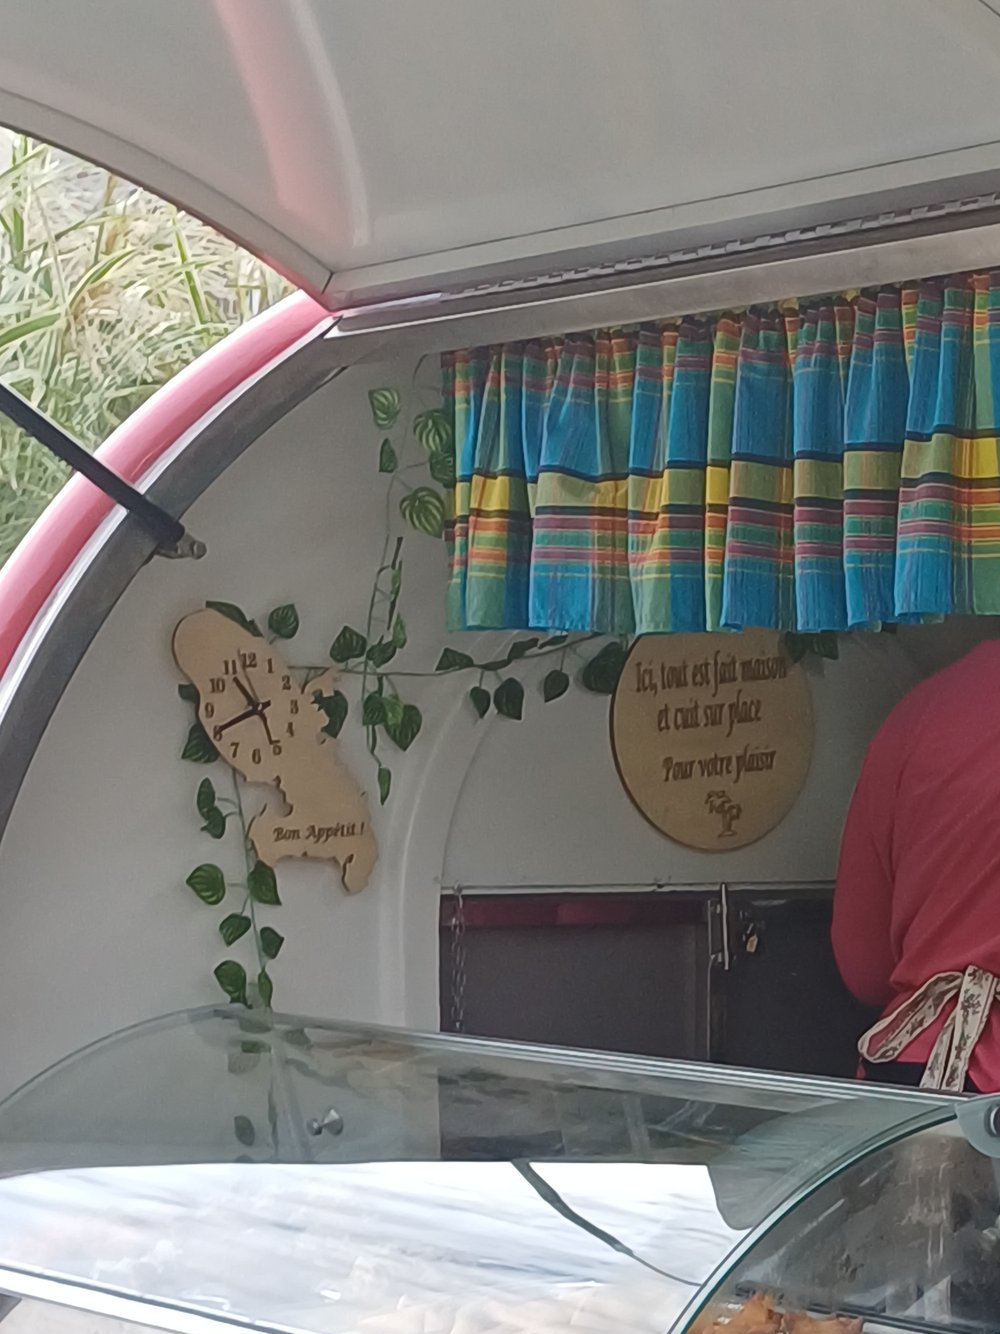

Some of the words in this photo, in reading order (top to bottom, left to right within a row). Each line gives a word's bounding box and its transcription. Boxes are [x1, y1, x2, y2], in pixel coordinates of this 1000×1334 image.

[223, 660, 237, 675] 11
[241, 653, 257, 668] 12
[267, 659, 274, 673] 1
[635, 661, 658, 696] Ici,
[661, 661, 688, 690] tout
[692, 660, 710, 687] est
[712, 650, 738, 698] fait
[740, 654, 788, 682] maison
[210, 679, 225, 693] 10
[282, 675, 291, 690] 2
[205, 703, 214, 718] 9
[290, 700, 299, 714] 3
[657, 704, 670, 732] et
[674, 698, 699, 730] cuit
[704, 703, 725, 727] sur
[725, 689, 762, 738] place
[213, 725, 223, 741] 8
[286, 722, 294, 736] 4
[230, 743, 239, 758] 7
[272, 740, 282, 755] 5
[252, 749, 261, 764] 6
[662, 756, 696, 782] Pour
[698, 752, 732, 778] votre
[733, 743, 777, 784] plaisir
[273, 827, 301, 842] Bon
